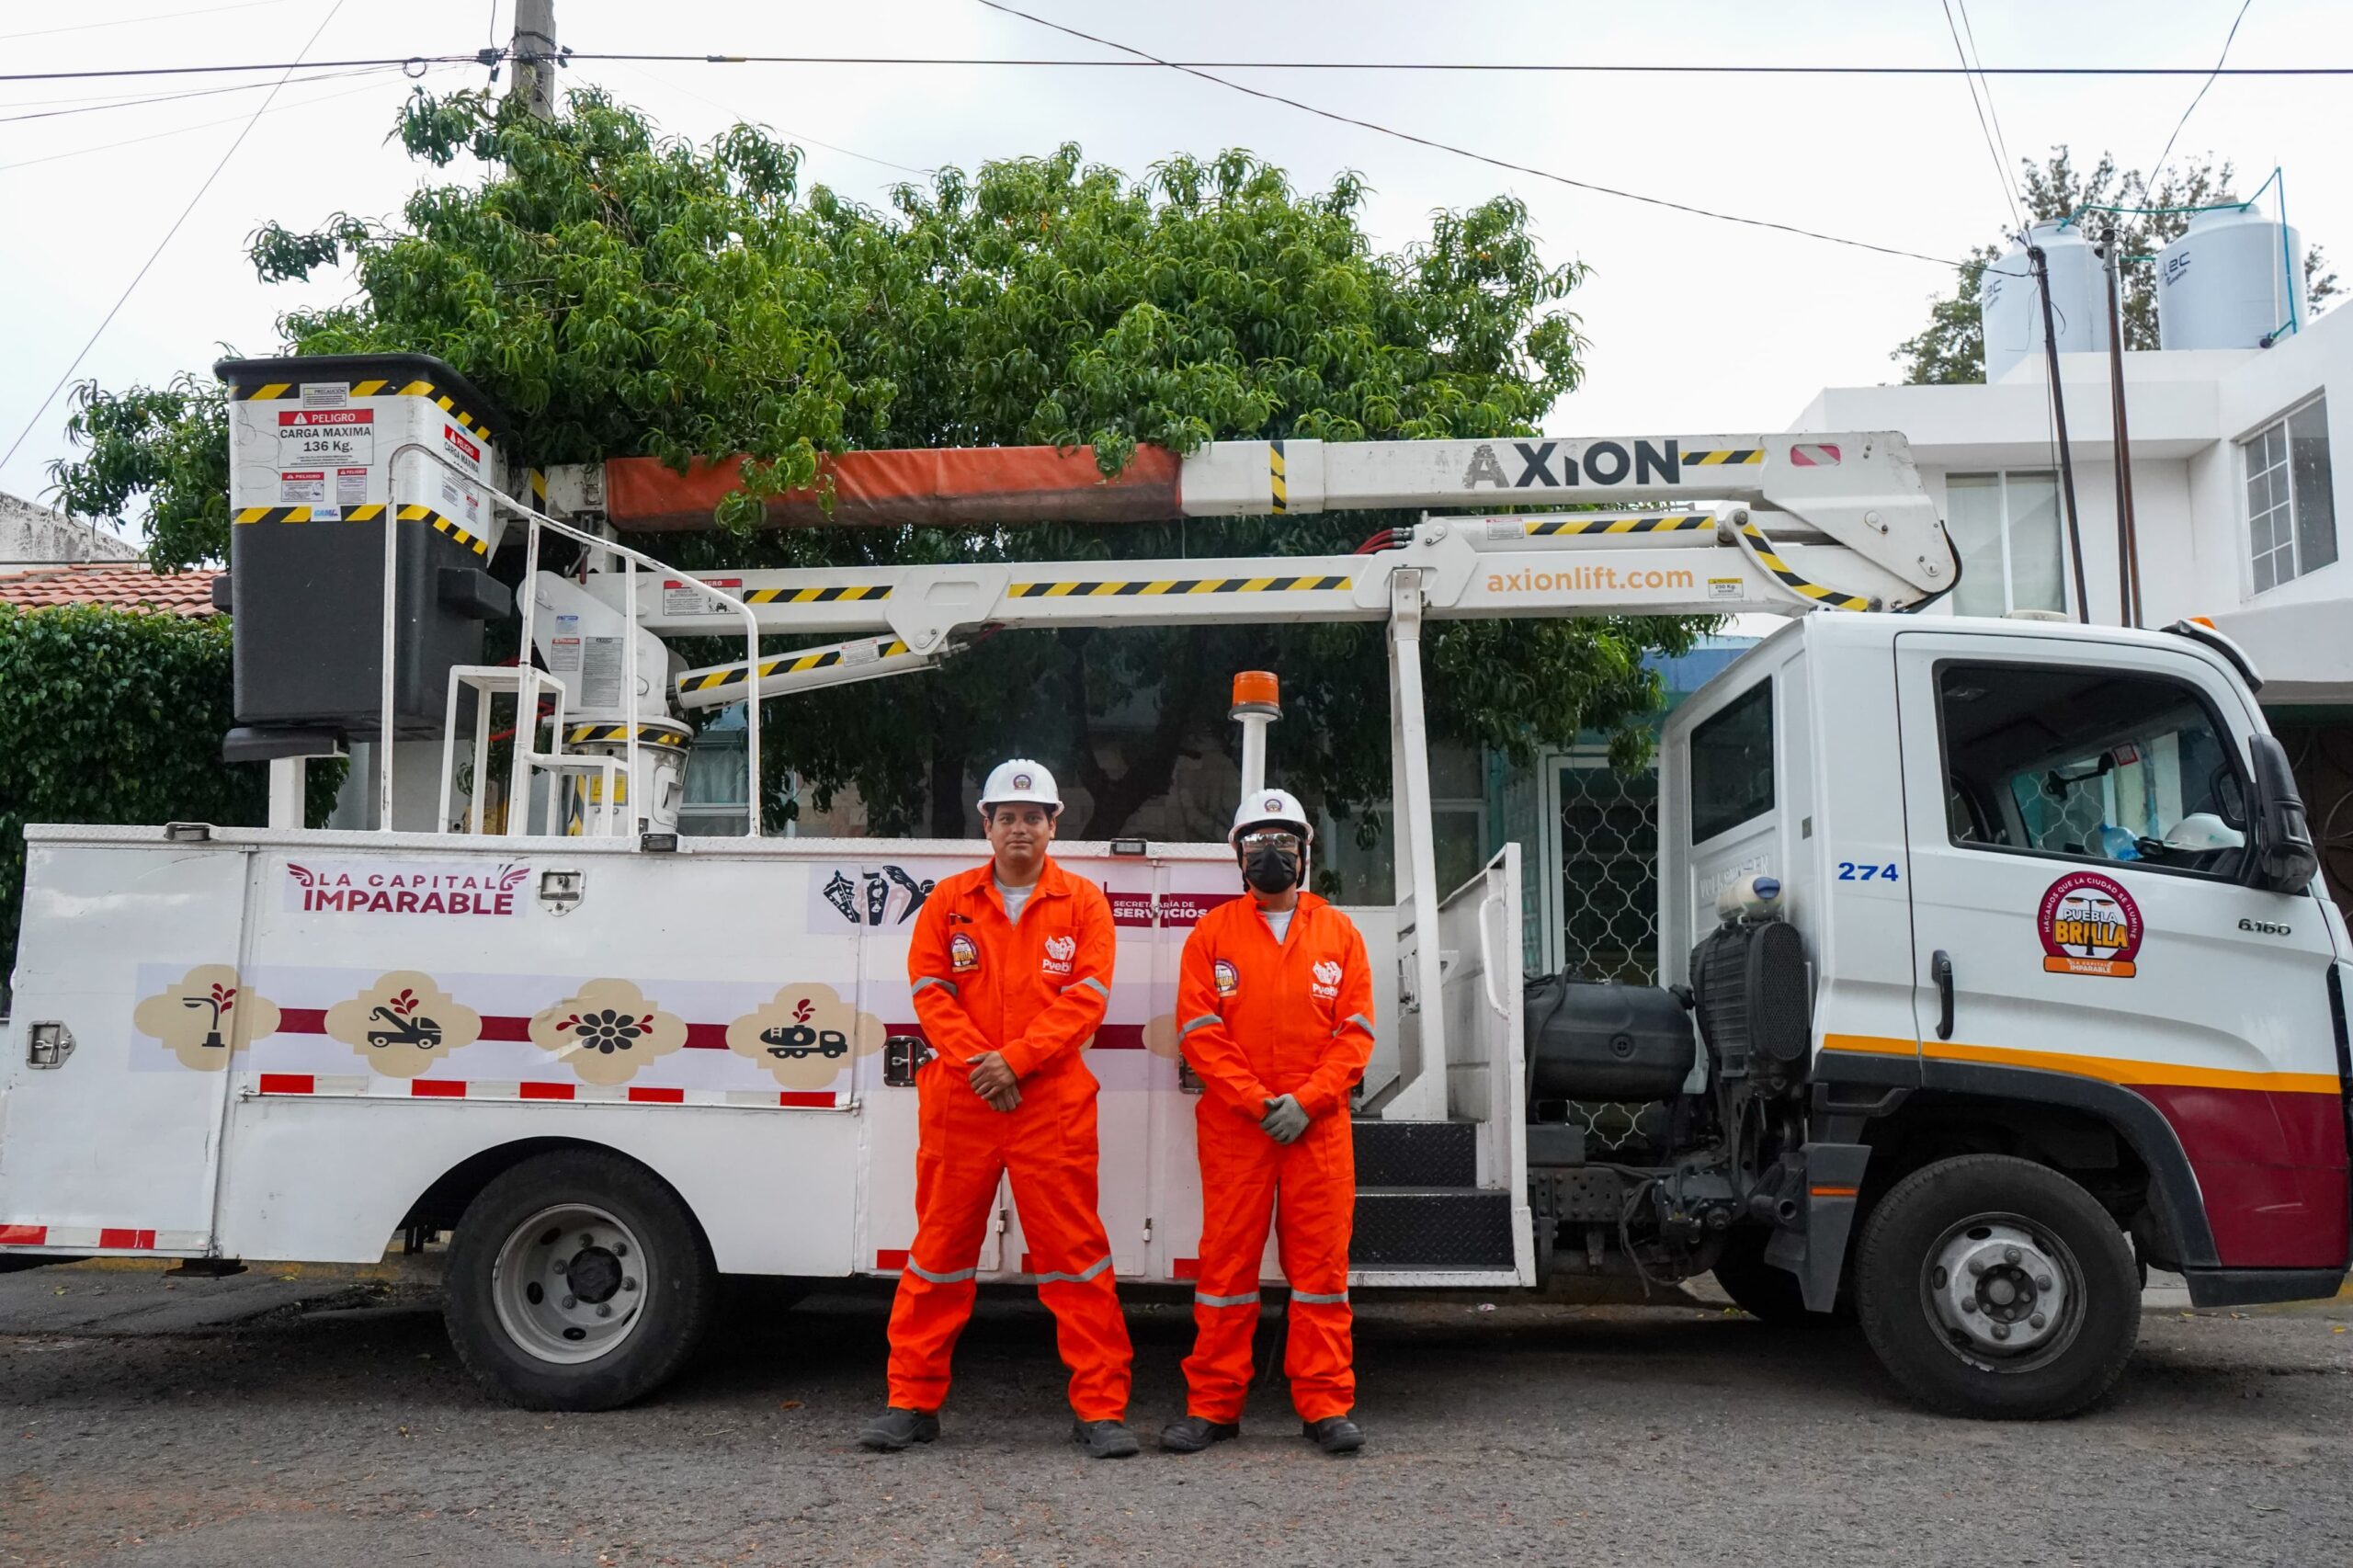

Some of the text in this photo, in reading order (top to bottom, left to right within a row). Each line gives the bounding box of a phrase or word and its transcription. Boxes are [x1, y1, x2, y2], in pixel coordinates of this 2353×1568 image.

[312, 413, 357, 423] PELIGRO
[279, 426, 372, 439] CARGA MAXIMA
[303, 440, 354, 453] 136 Kg.
[444, 441, 460, 460] CARGA
[1487, 566, 1694, 593] axionlift.com
[1838, 862, 1899, 881] 274
[319, 873, 496, 890] LA CAPITAL
[303, 889, 514, 915] IMPARABLE
[2043, 892, 2059, 933] HAGAMOS
[2058, 880, 2074, 893] QUE
[2086, 877, 2118, 893] CIUDAD
[2118, 892, 2128, 903] SE
[2126, 903, 2138, 939] ILUMINE
[2063, 908, 2118, 923] PUEBLA
[2054, 919, 2129, 949] BRILLA
[2238, 918, 2291, 936] 6.160
